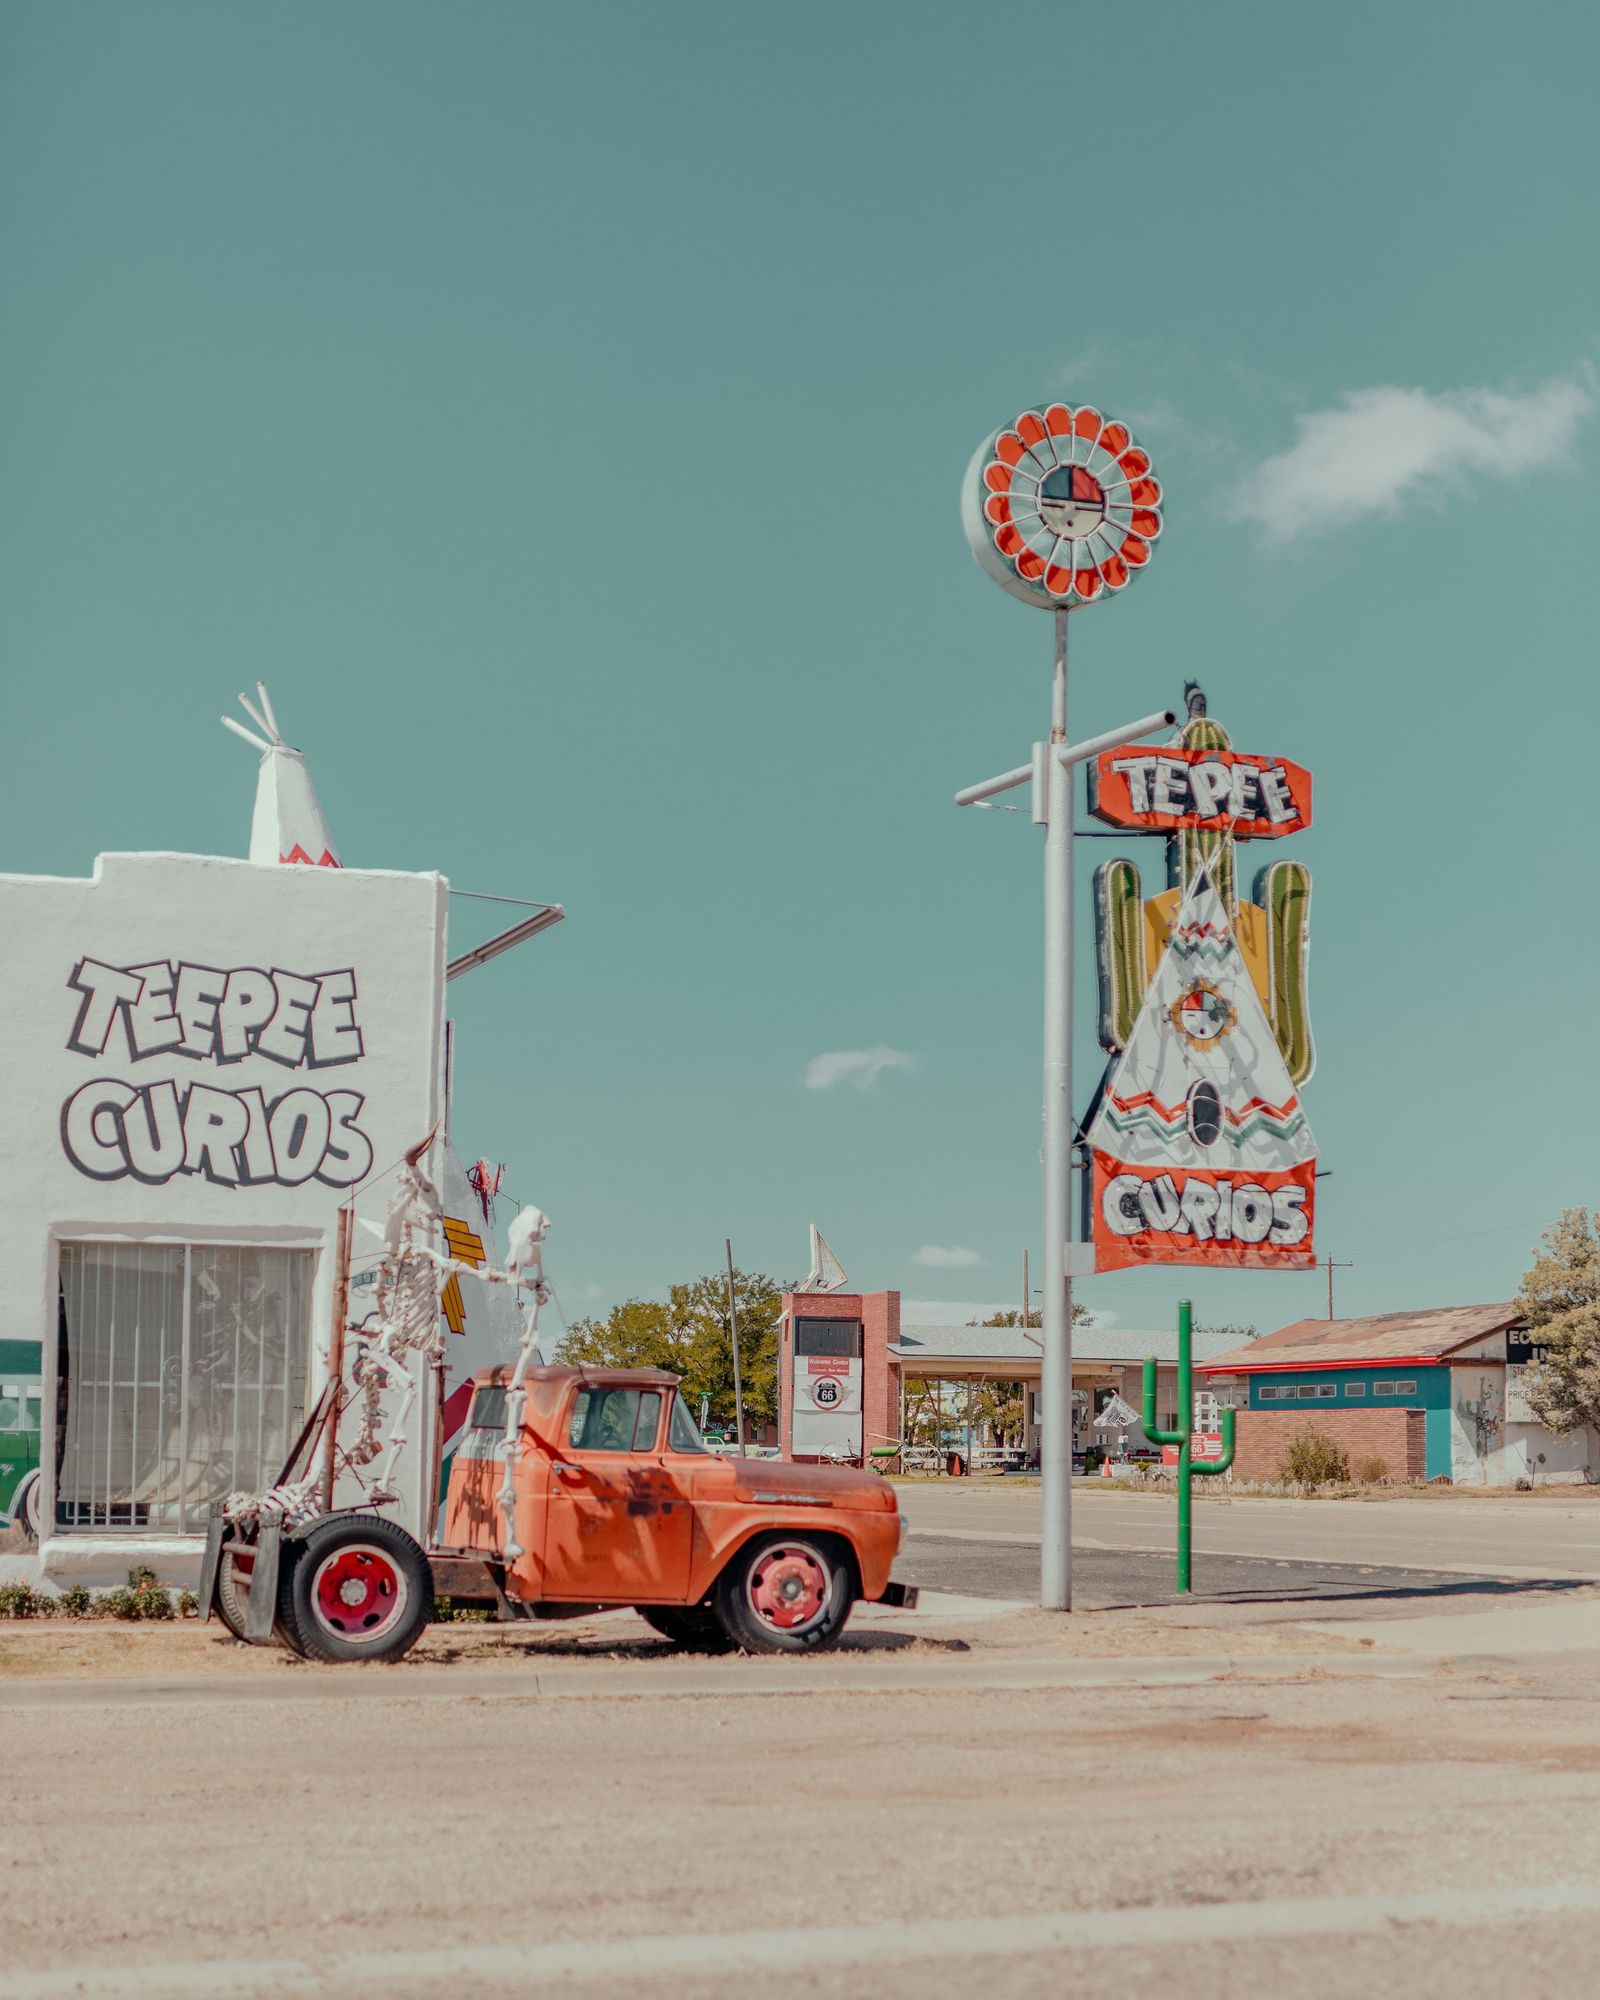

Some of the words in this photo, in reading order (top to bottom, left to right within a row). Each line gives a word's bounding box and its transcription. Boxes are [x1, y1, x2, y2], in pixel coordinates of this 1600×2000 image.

[1111, 755, 1299, 824] TEPEE
[65, 955, 366, 1071] TEEPEE
[60, 1077, 374, 1189] CURIOS
[1102, 1173, 1310, 1246] CURIOS
[821, 1390, 833, 1401] 66
[1191, 1444, 1203, 1454] 66
